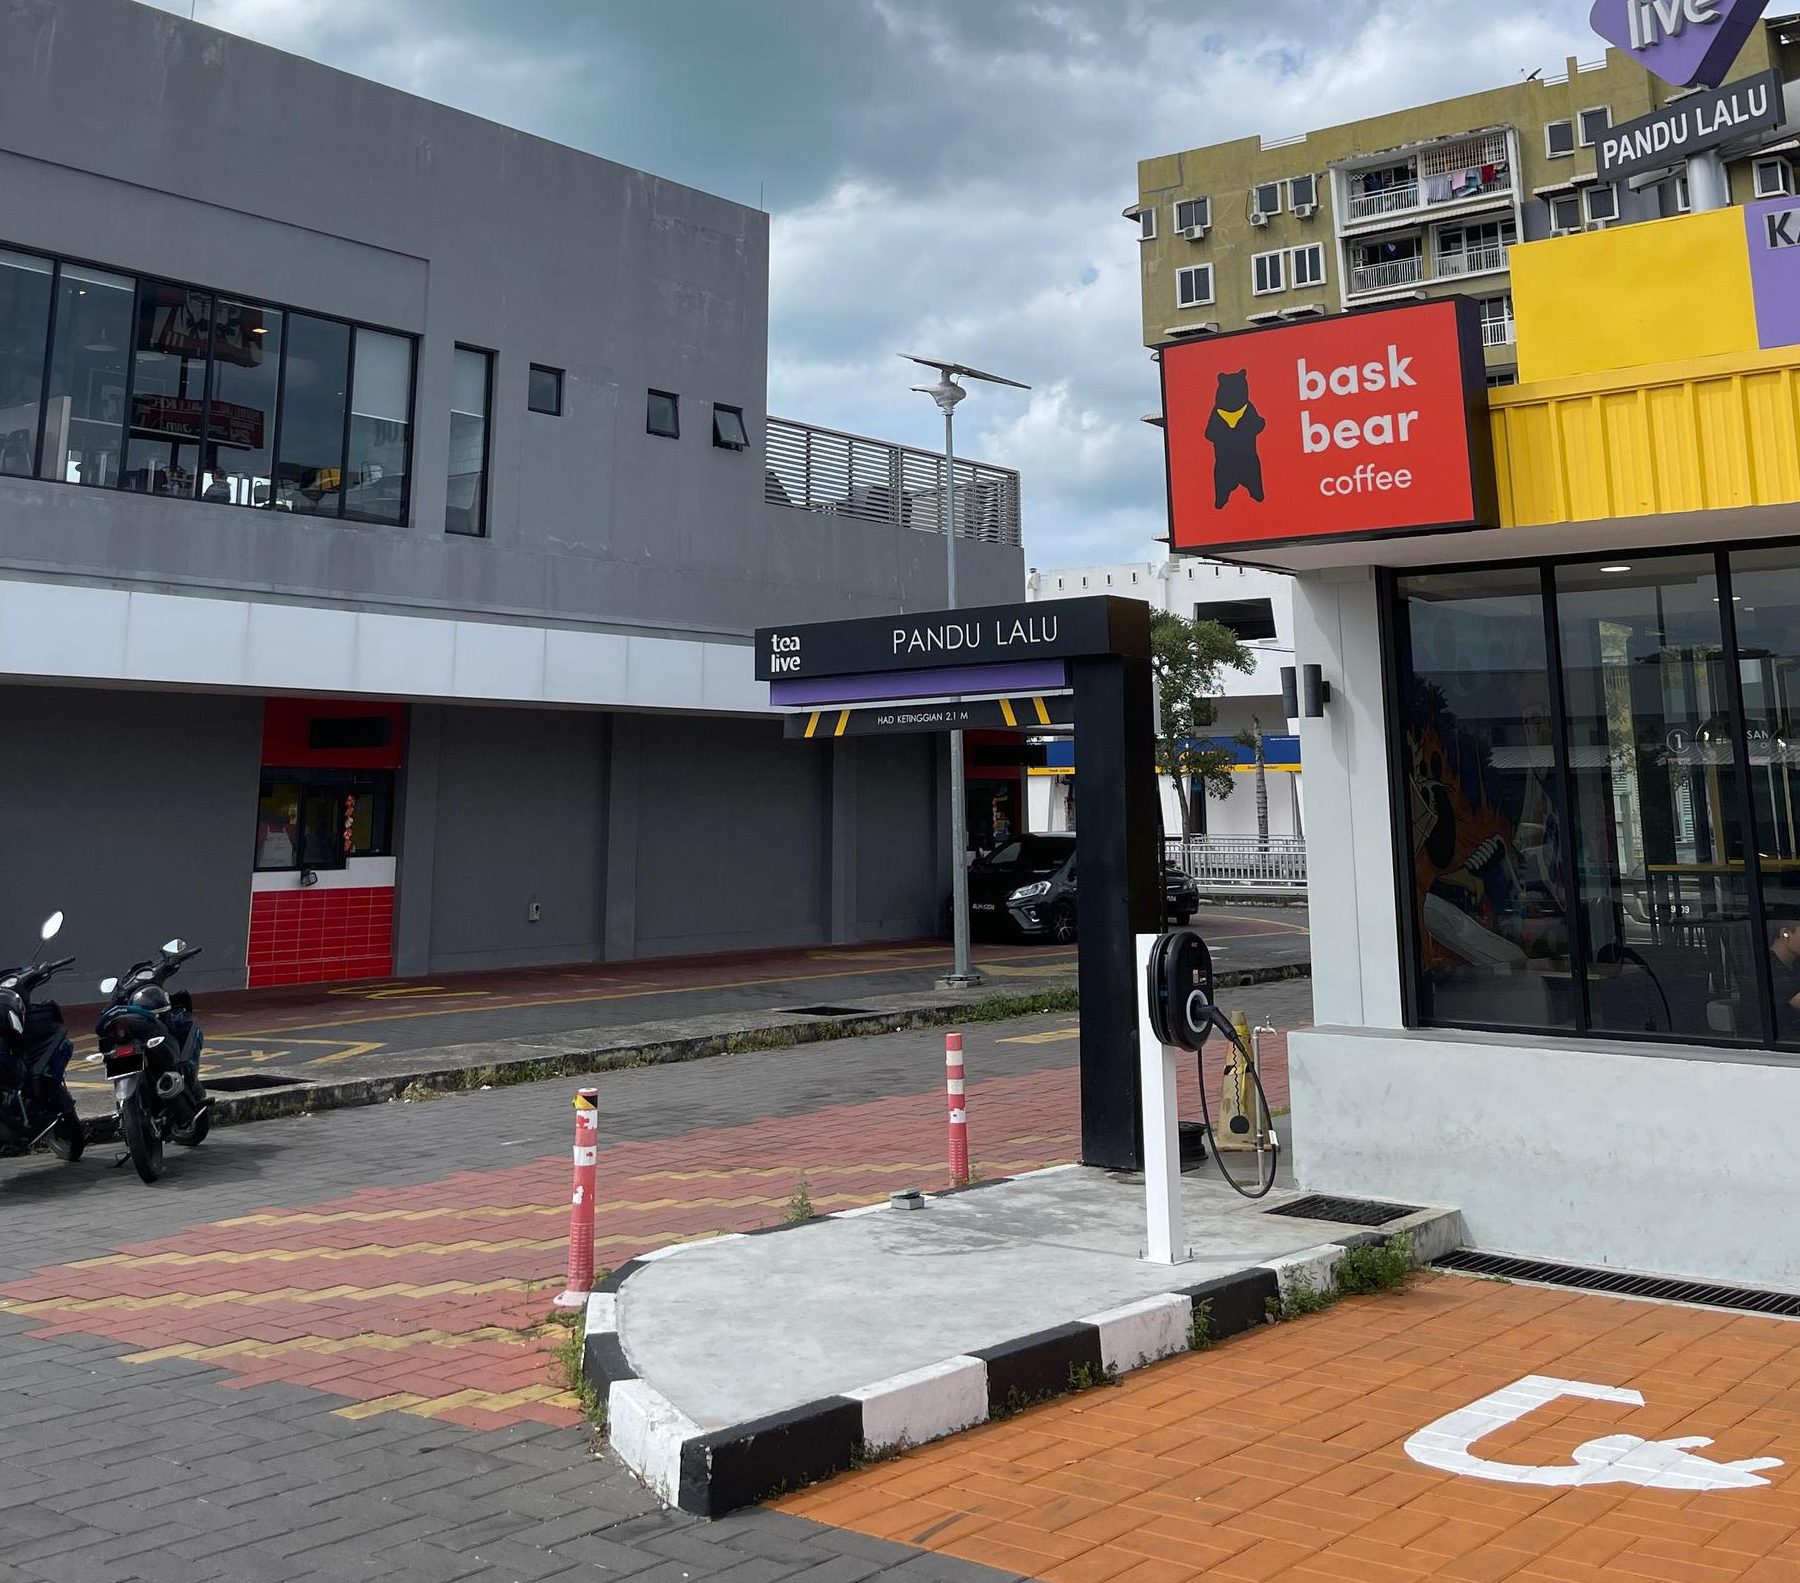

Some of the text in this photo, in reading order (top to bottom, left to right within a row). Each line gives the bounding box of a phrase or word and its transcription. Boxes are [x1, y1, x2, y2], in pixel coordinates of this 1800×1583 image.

[1628, 0, 1721, 49] live
[1602, 85, 1768, 169] PANDU LALU
[1767, 212, 1800, 248] K
[1297, 344, 1417, 400] bask
[1301, 410, 1418, 453] bear
[1319, 463, 1412, 496] coffee
[770, 633, 801, 652] tea
[893, 615, 1058, 654] PANDU LALU
[770, 654, 801, 673] live
[877, 711, 968, 725] HAD KETINGGIAN 2.1 M
